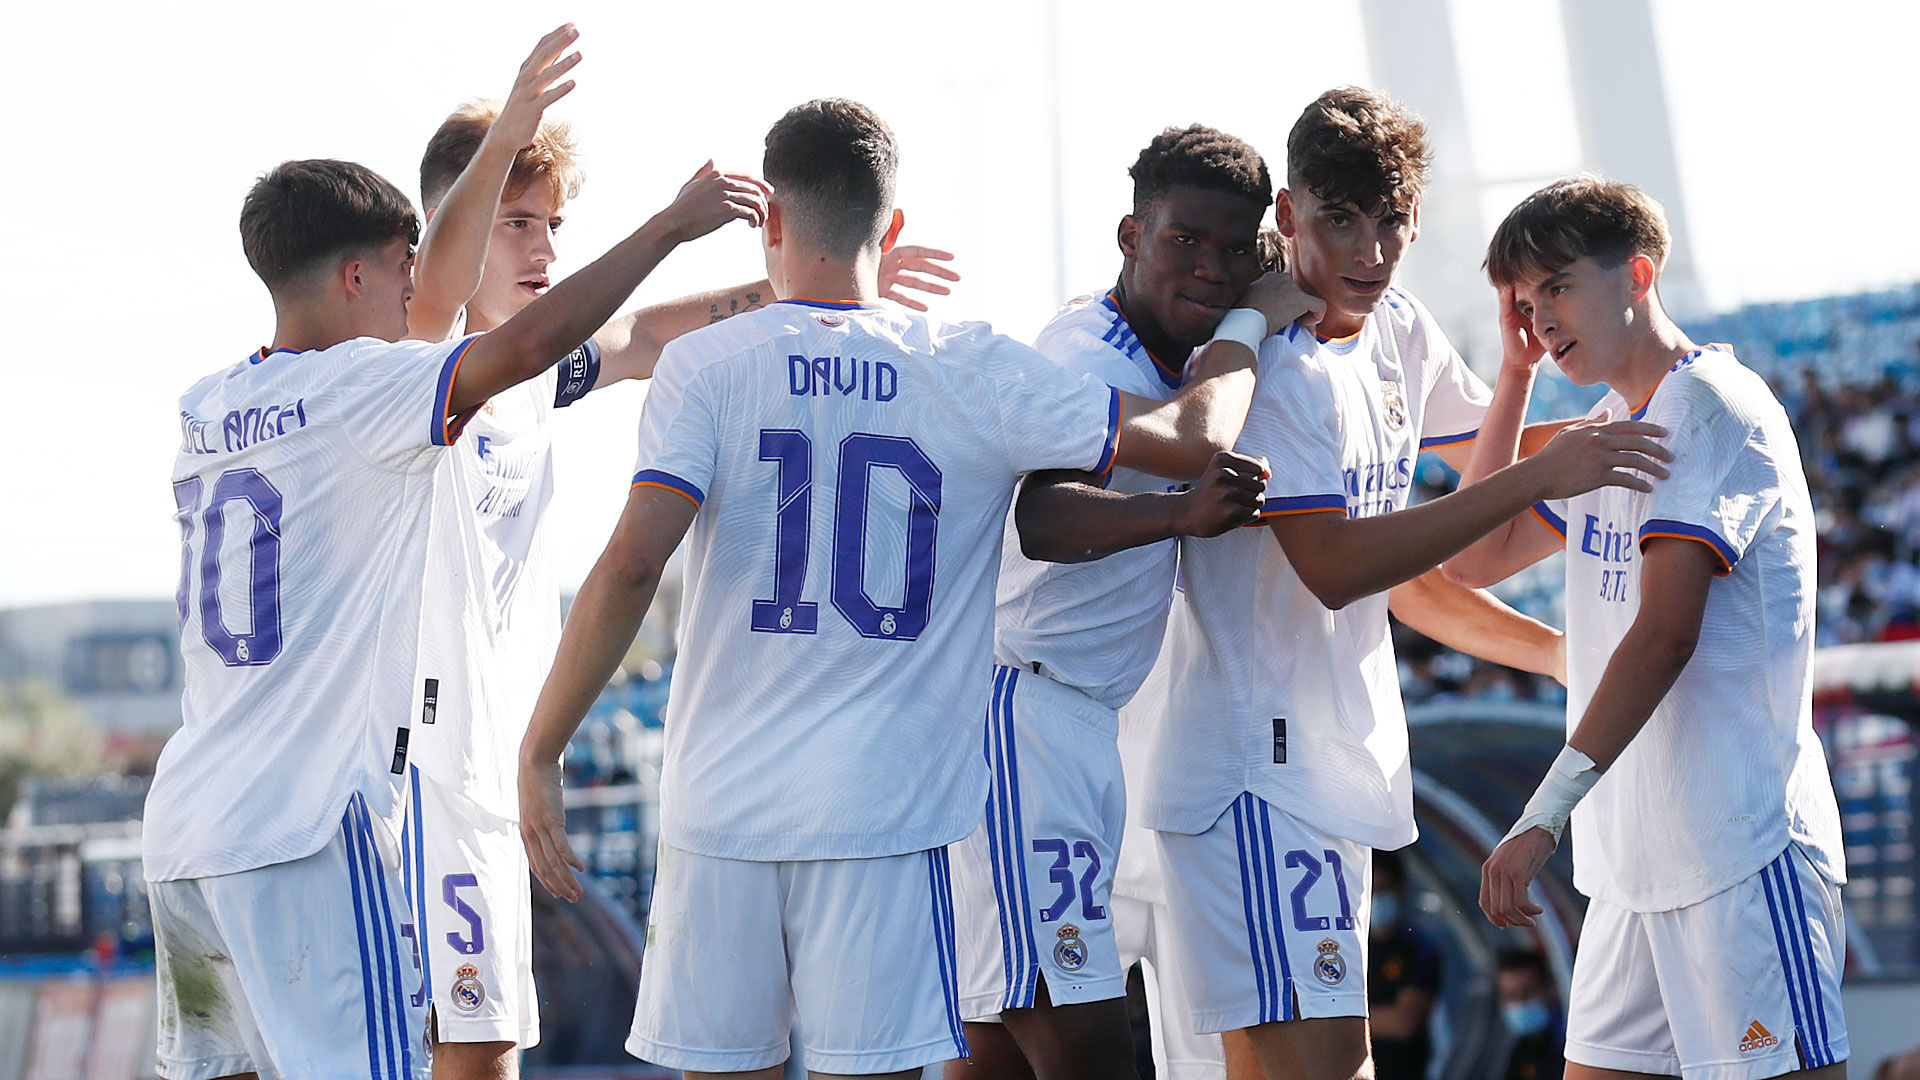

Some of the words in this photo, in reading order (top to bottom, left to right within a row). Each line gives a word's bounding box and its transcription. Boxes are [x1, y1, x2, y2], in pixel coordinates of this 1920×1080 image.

[788, 355, 898, 402] DAVID
[751, 428, 942, 642] 10
[442, 873, 485, 954] 5
[1033, 839, 1106, 922] 32
[1284, 849, 1356, 932] 21
[1739, 1035, 1779, 1052] adidas
